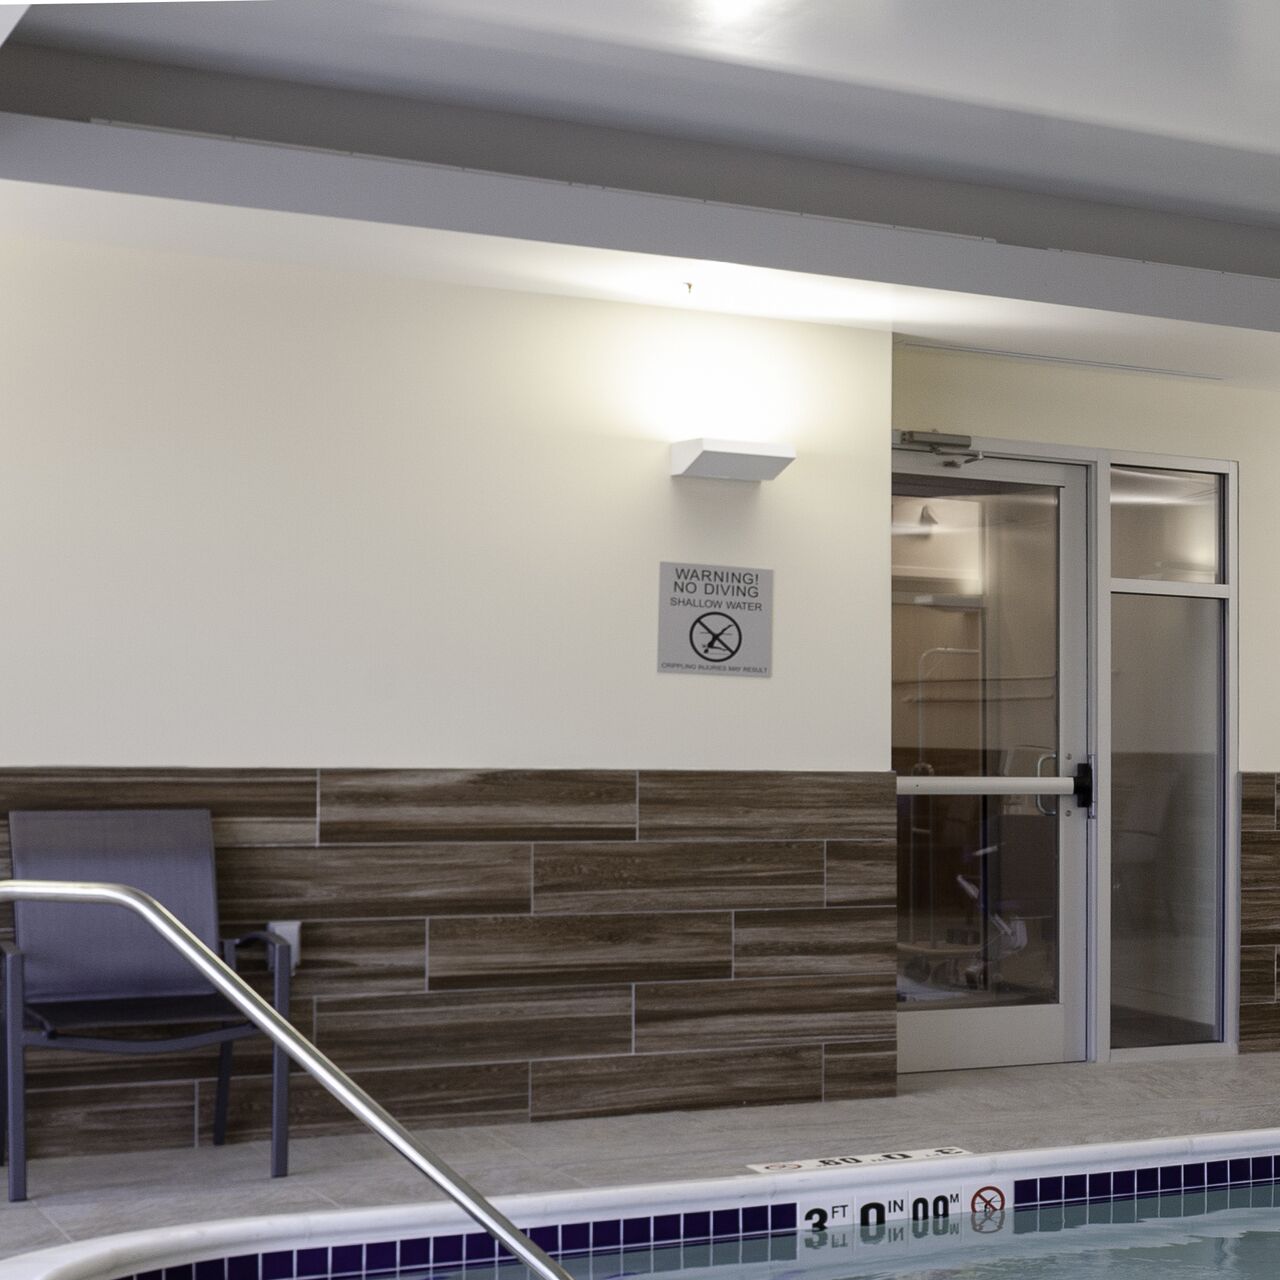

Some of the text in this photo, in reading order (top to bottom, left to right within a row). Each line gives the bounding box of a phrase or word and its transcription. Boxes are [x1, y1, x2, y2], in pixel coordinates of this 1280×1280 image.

[675, 568, 759, 585] WARNING!
[673, 581, 759, 598] NO DIVING
[670, 597, 762, 611] SHALLOW WATER
[832, 1205, 848, 1218] FT
[861, 1202, 885, 1226] 0
[888, 1199, 904, 1213] IN
[950, 1193, 959, 1203] M
